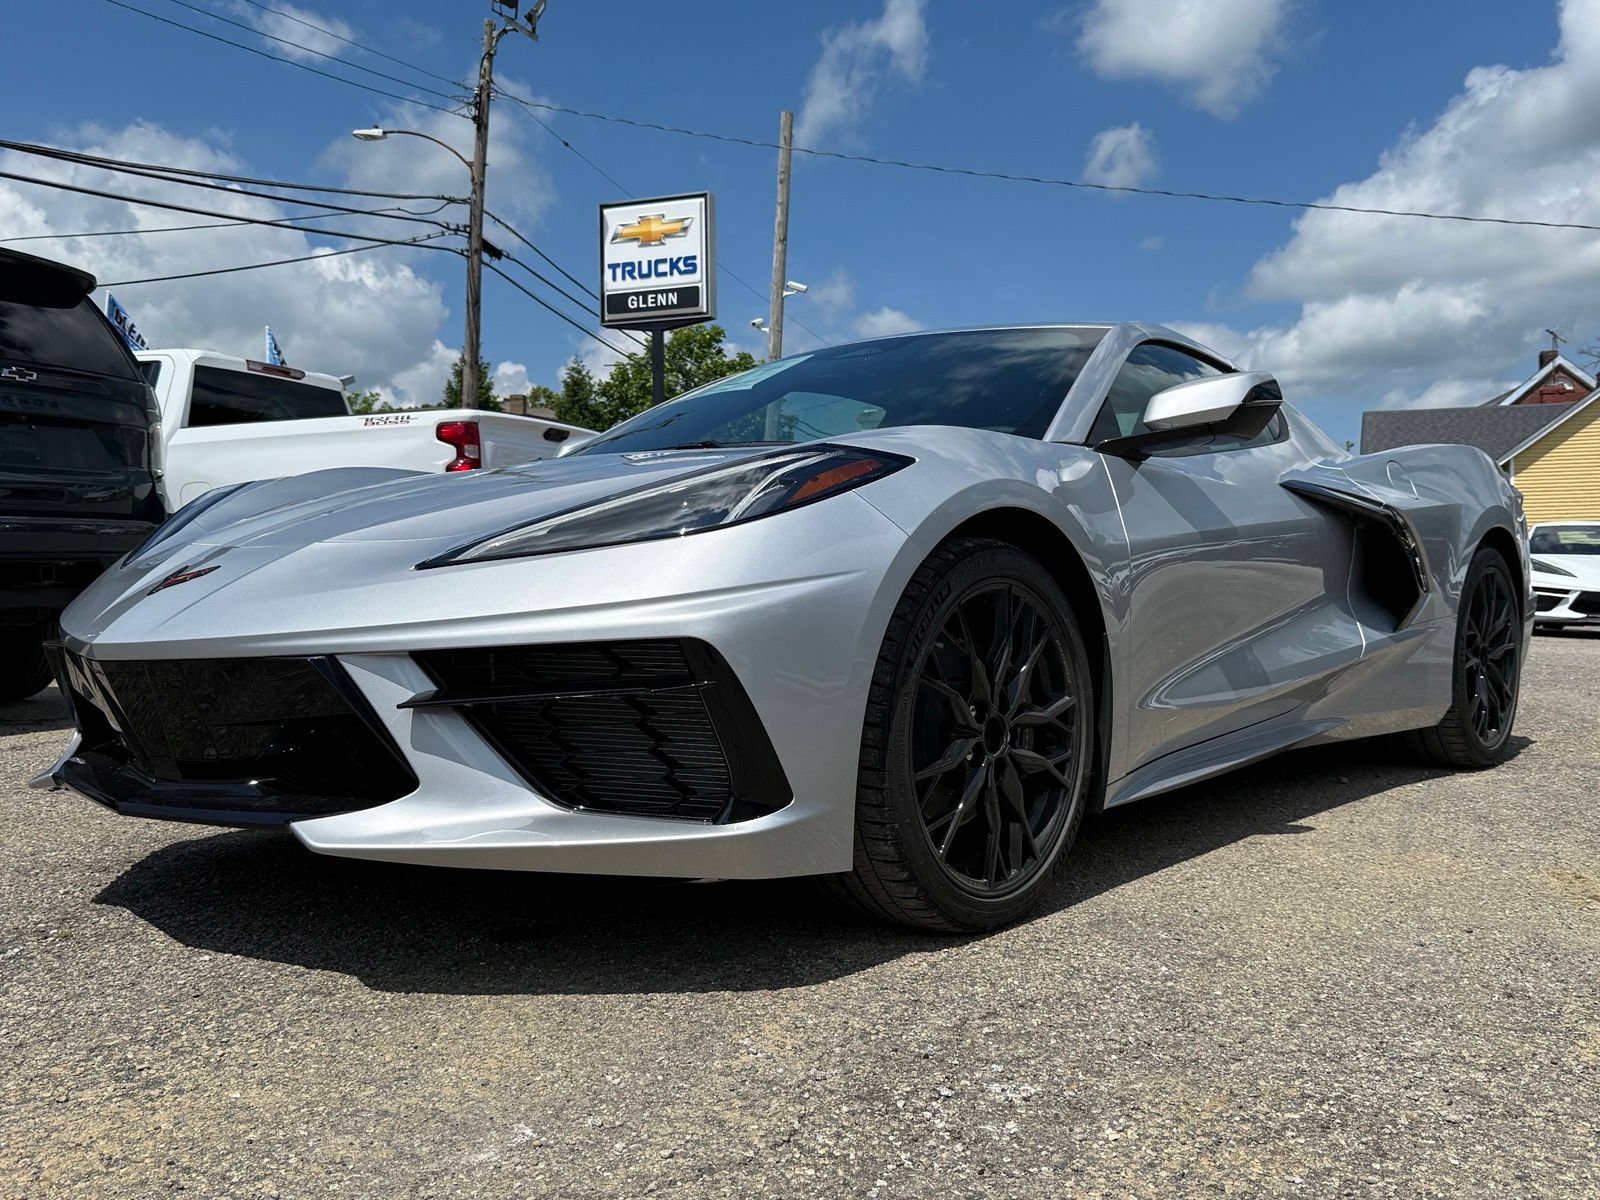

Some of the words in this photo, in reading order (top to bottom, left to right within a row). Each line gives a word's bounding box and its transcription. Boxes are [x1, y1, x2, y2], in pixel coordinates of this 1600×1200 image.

[607, 255, 698, 282] TRUCKS
[628, 292, 678, 309] GLENN
[114, 308, 149, 350] GLEN
